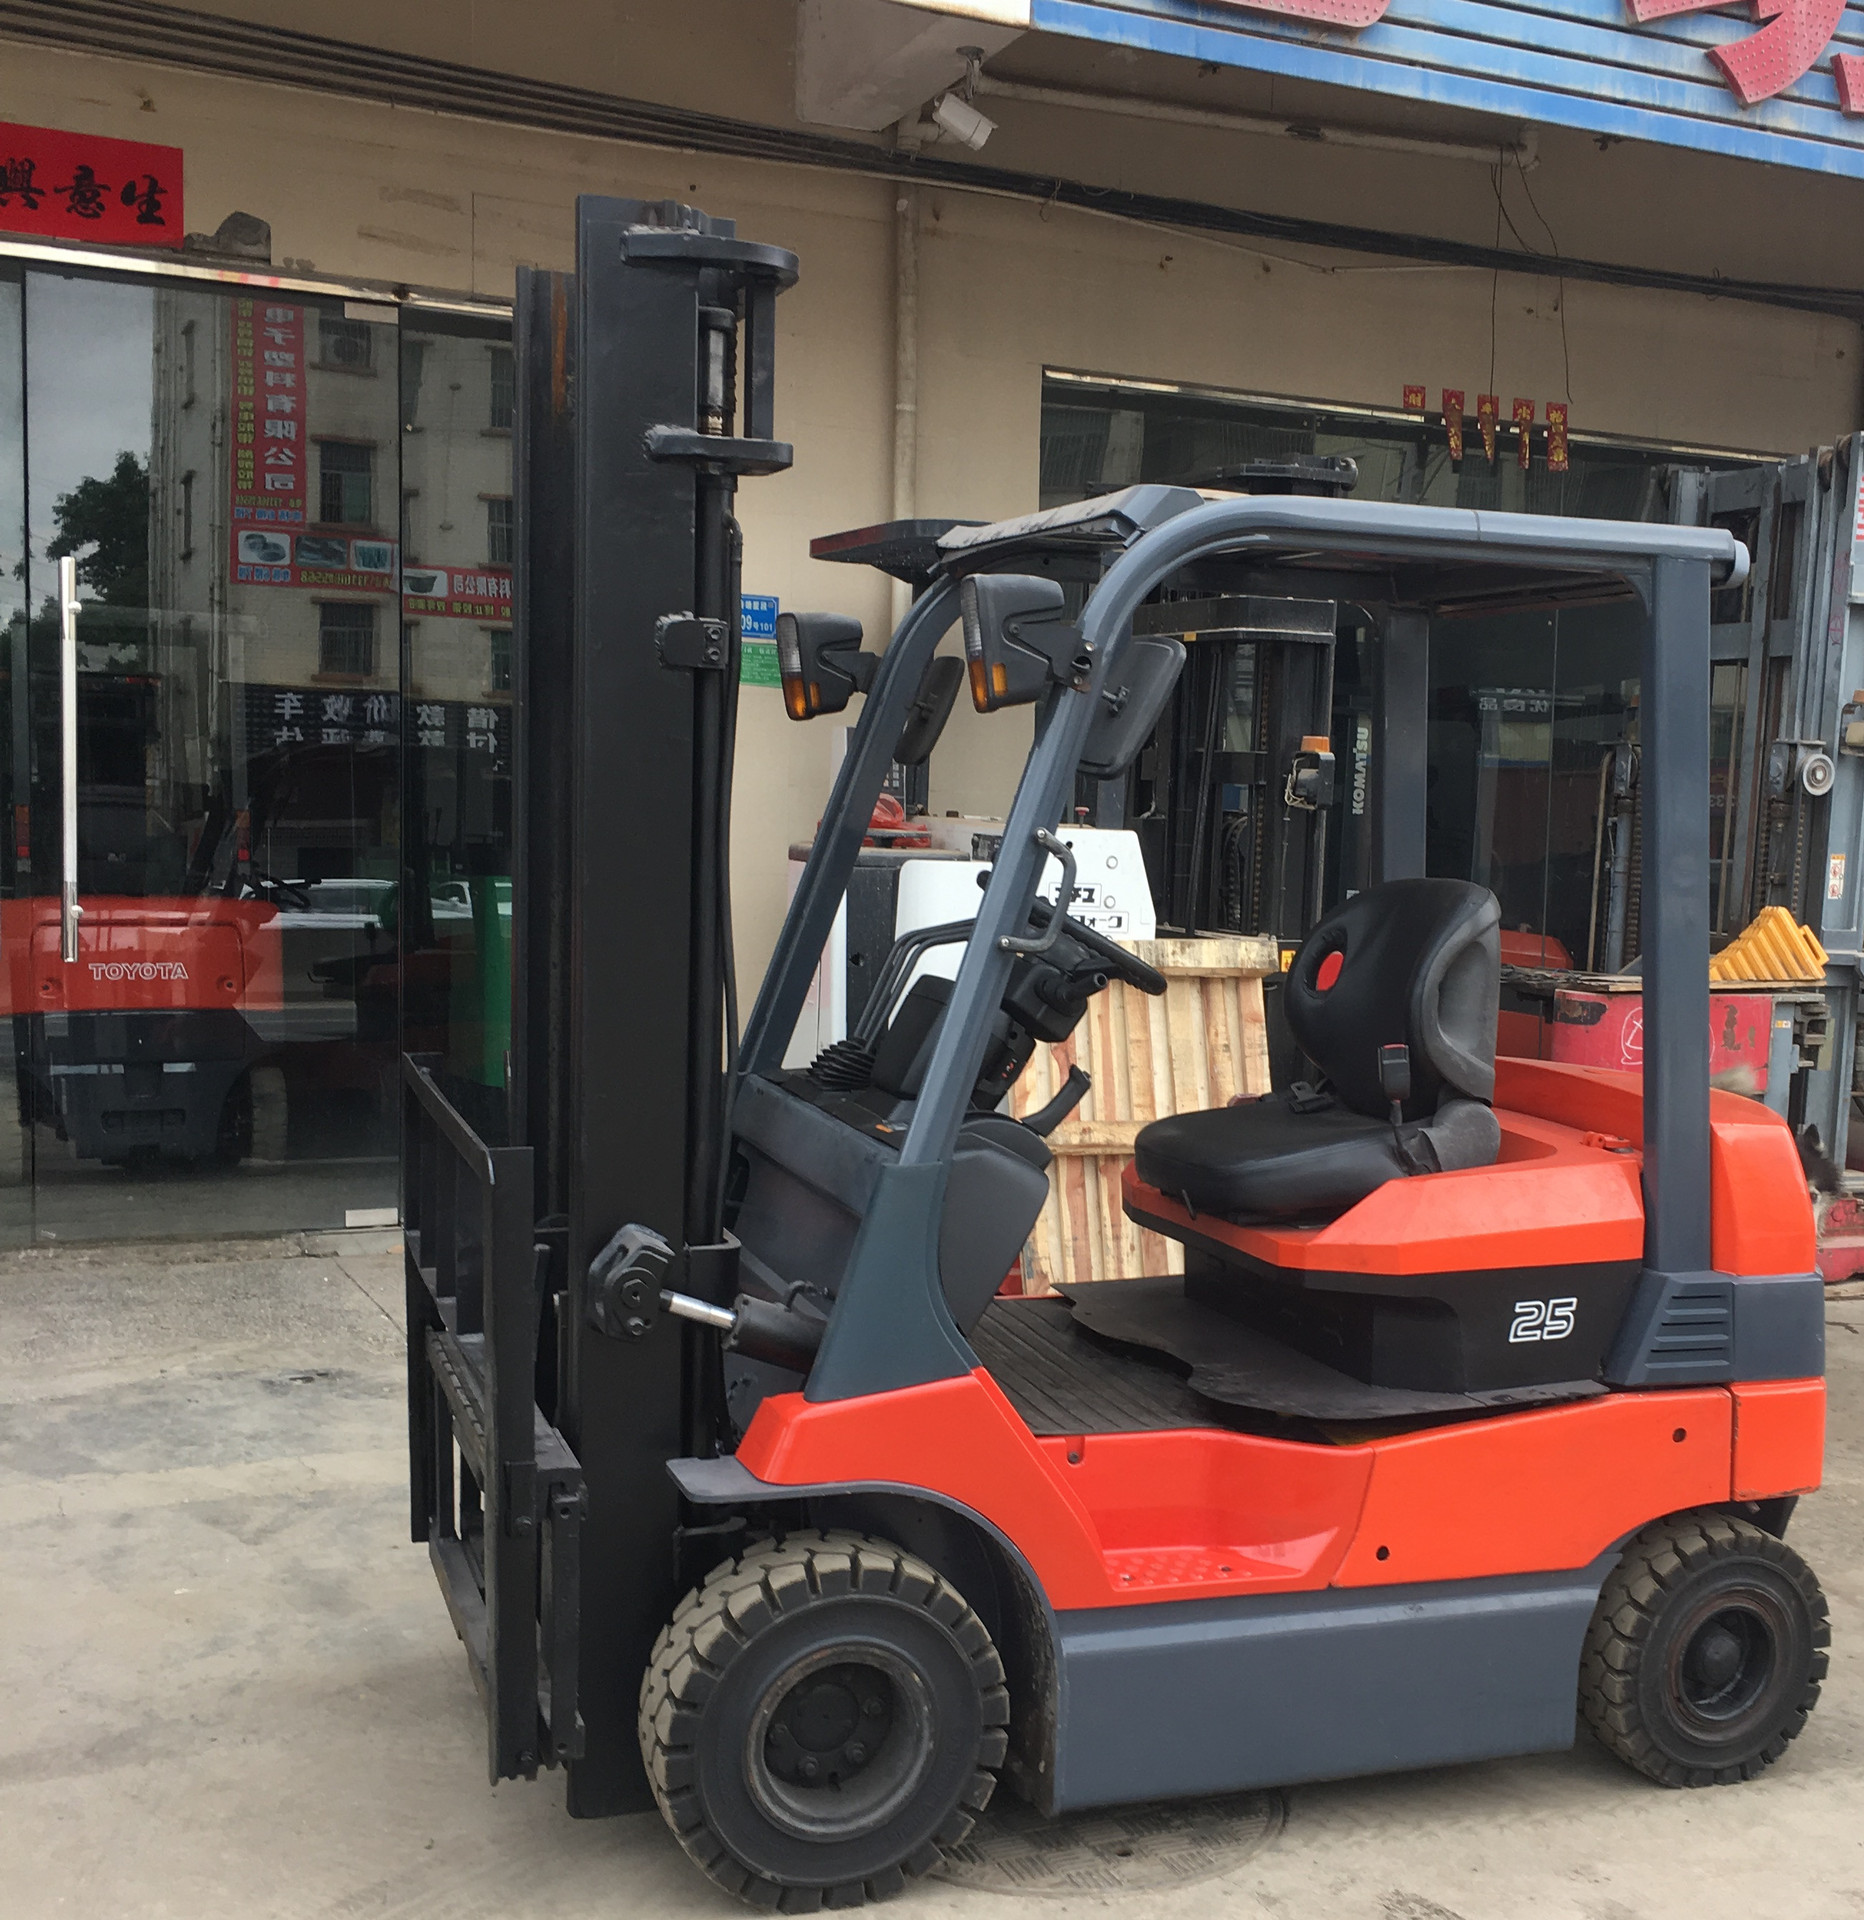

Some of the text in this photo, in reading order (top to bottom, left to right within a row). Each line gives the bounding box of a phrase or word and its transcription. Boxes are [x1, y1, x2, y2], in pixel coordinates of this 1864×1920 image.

[1352, 727, 1369, 815] KOMATSU
[88, 962, 188, 980] TOYOTA
[1508, 1297, 1577, 1344] 25
